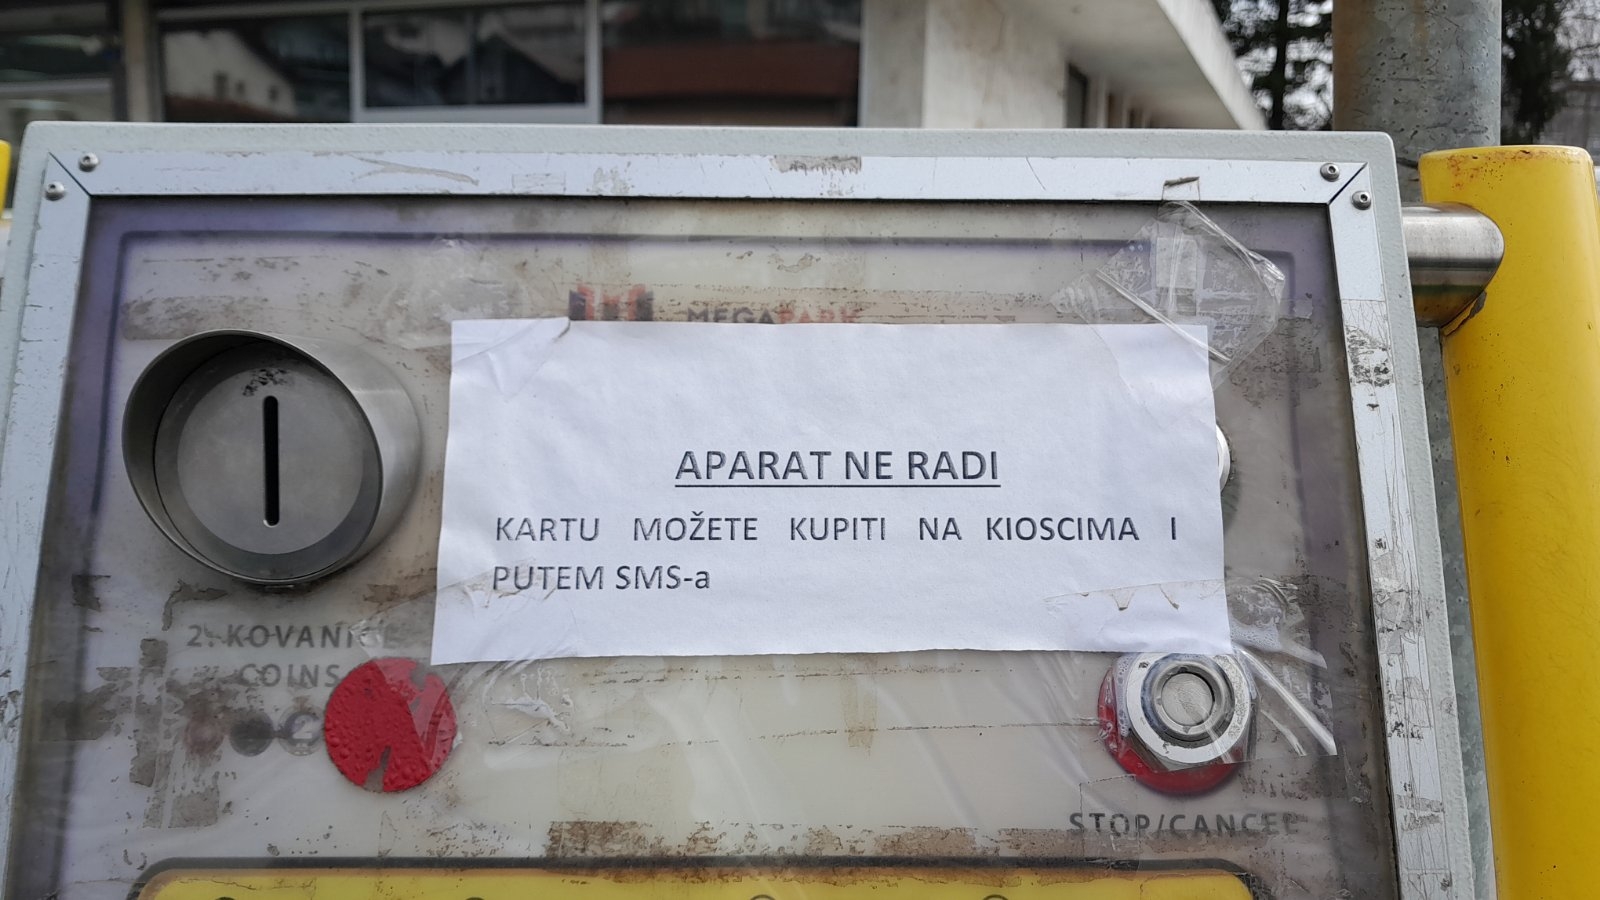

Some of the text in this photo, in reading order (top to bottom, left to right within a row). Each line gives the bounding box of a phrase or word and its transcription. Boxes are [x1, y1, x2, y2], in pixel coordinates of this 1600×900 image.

[674, 450, 999, 481] APARAT NE RADI
[495, 510, 1177, 542] KARTU MOŽETE KUPITI NA KIOSCIMA I
[492, 565, 711, 590] PUTEM SMS-a
[240, 663, 340, 688] COINS
